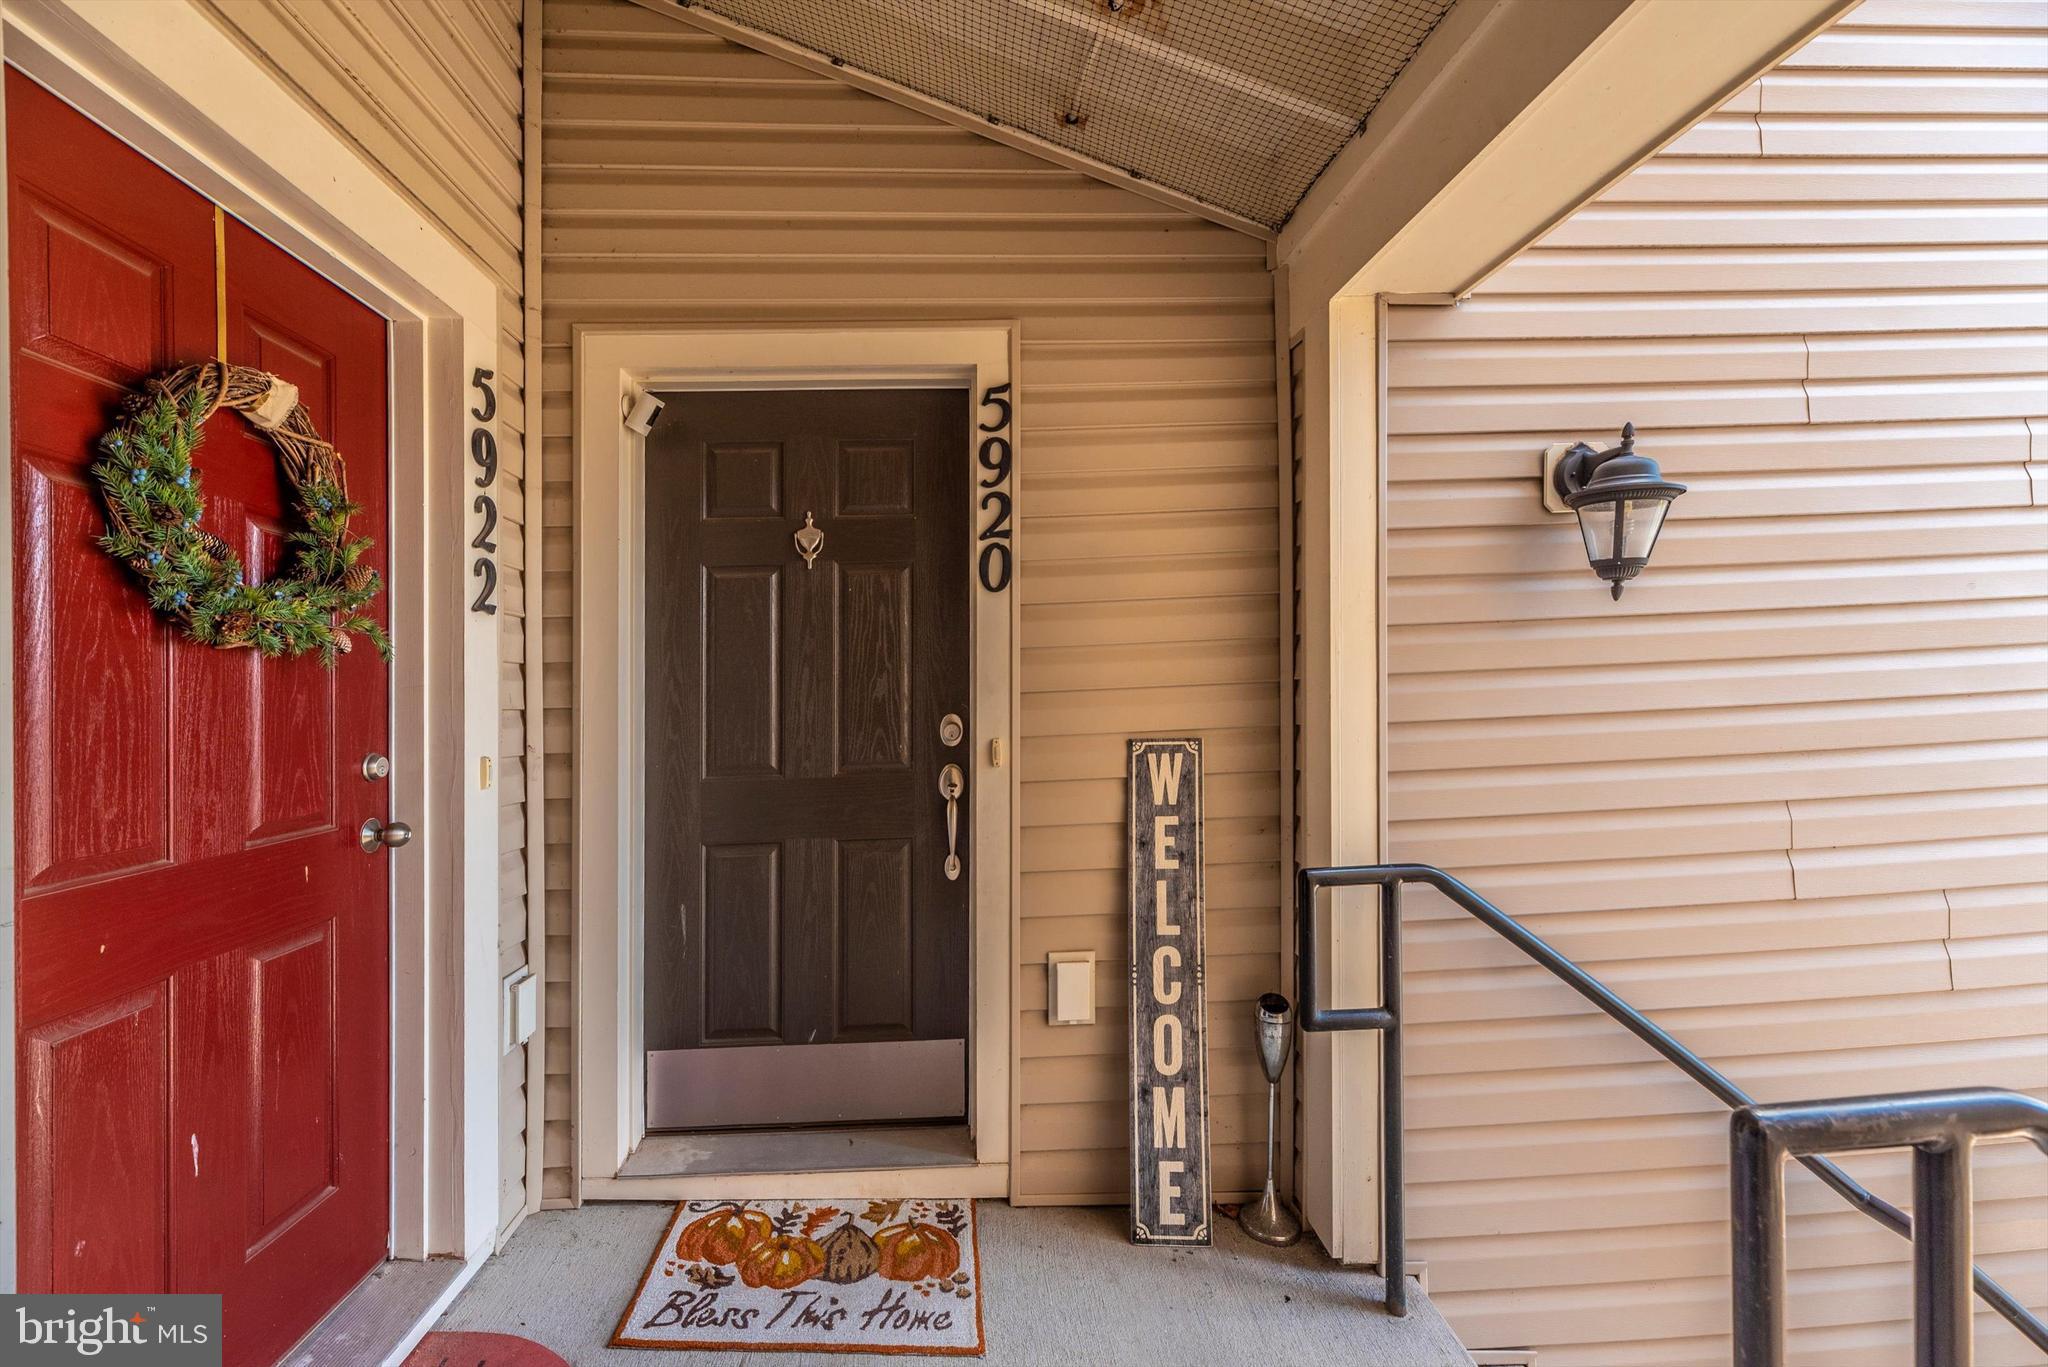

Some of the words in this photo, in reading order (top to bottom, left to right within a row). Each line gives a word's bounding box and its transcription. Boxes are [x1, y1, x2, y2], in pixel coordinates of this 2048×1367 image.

[471, 367, 498, 616] 5922
[978, 382, 1012, 592] 5920
[1146, 751, 1187, 1227] WELCOME
[643, 1289, 760, 1330] Bless
[765, 1290, 848, 1331] This
[860, 1287, 953, 1332] Home
